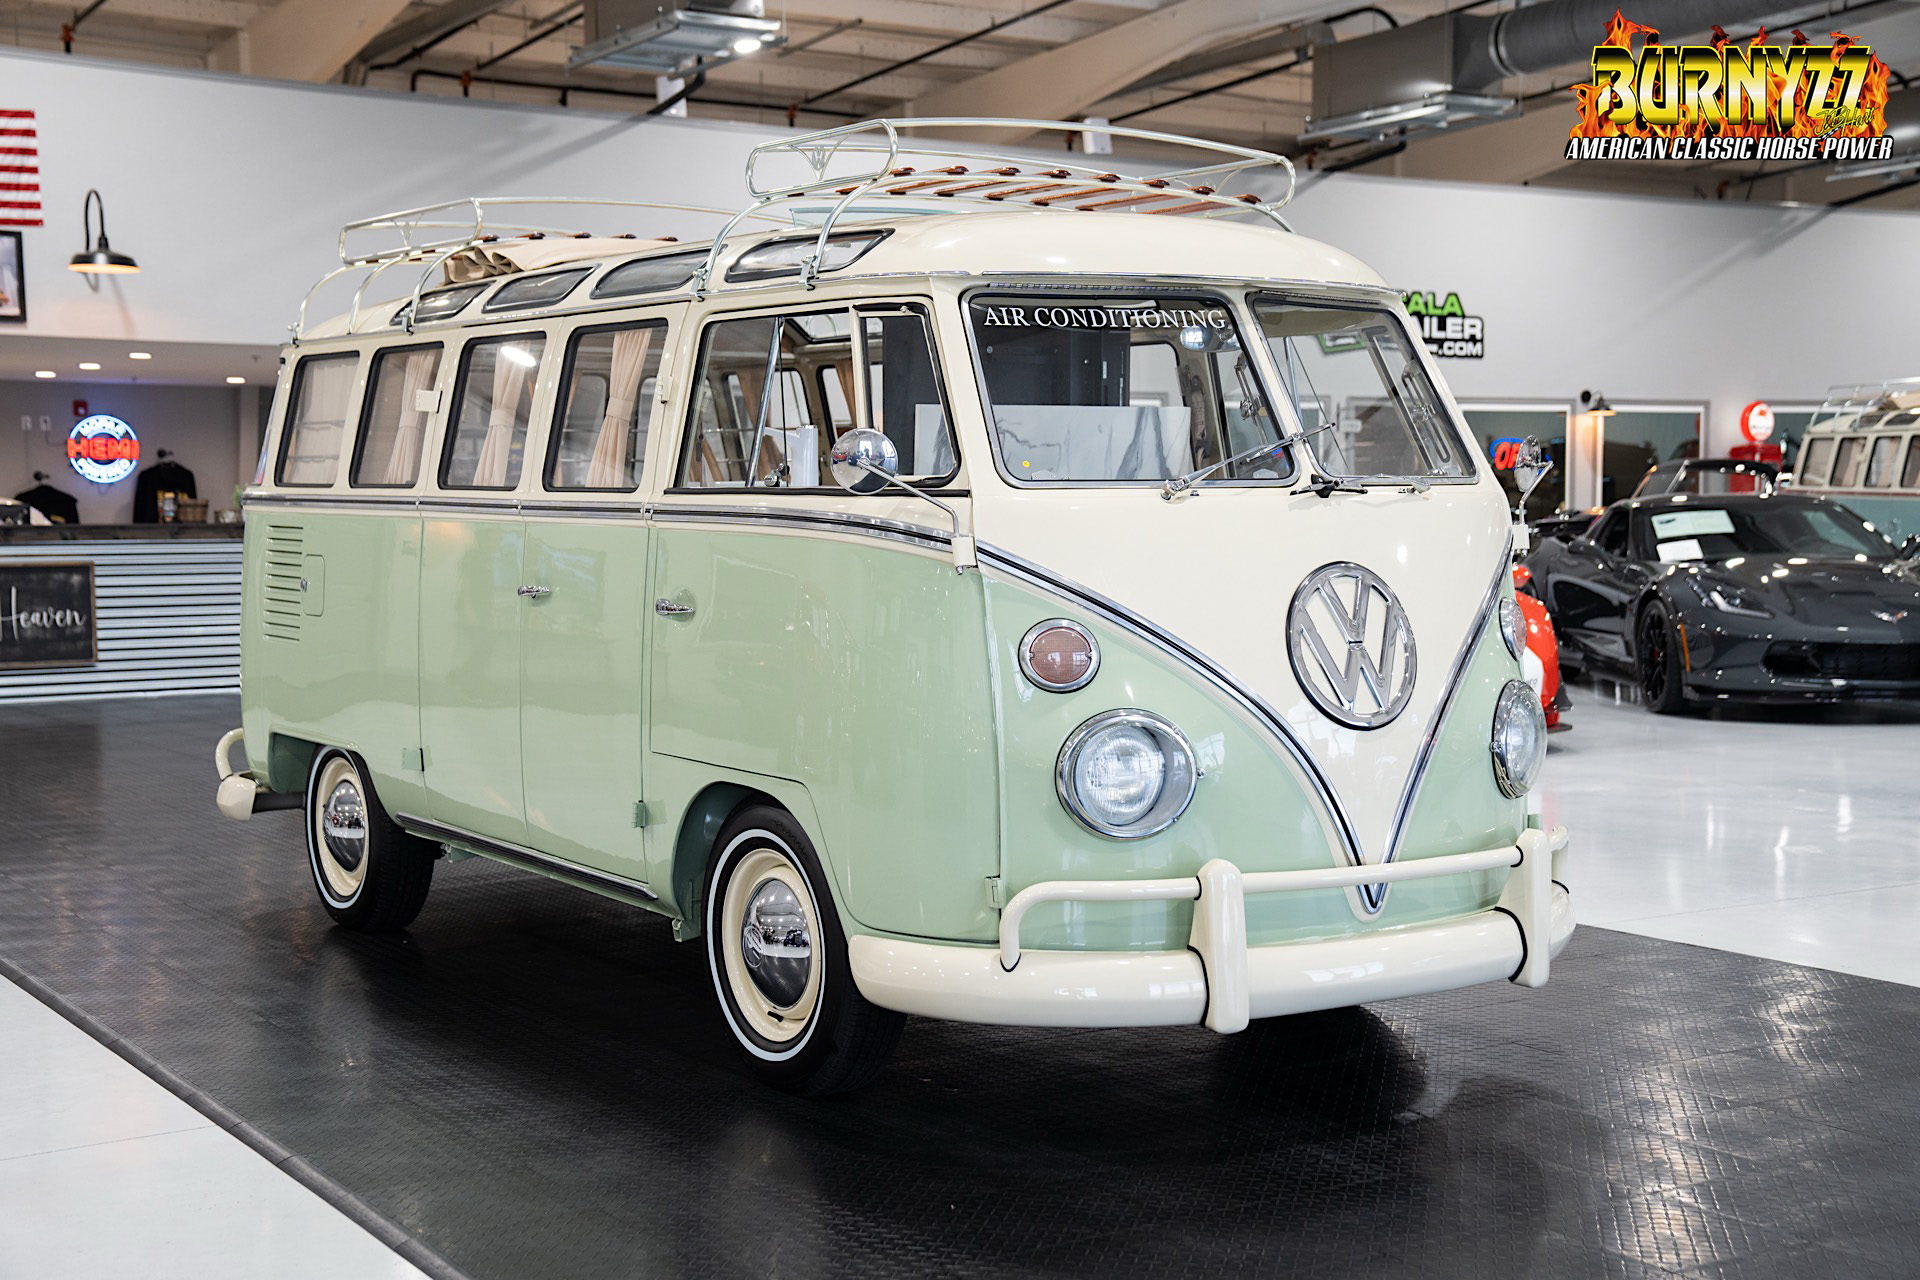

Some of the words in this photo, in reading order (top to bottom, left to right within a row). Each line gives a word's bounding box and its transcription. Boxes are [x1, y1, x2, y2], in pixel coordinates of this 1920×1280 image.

[1402, 291, 1463, 316] ALA
[984, 307, 1030, 327] AIR
[1034, 307, 1226, 329] CONDITIONING
[67, 437, 140, 461] HEMI
[1494, 442, 1521, 471] OP
[0, 586, 87, 642] Heaven
